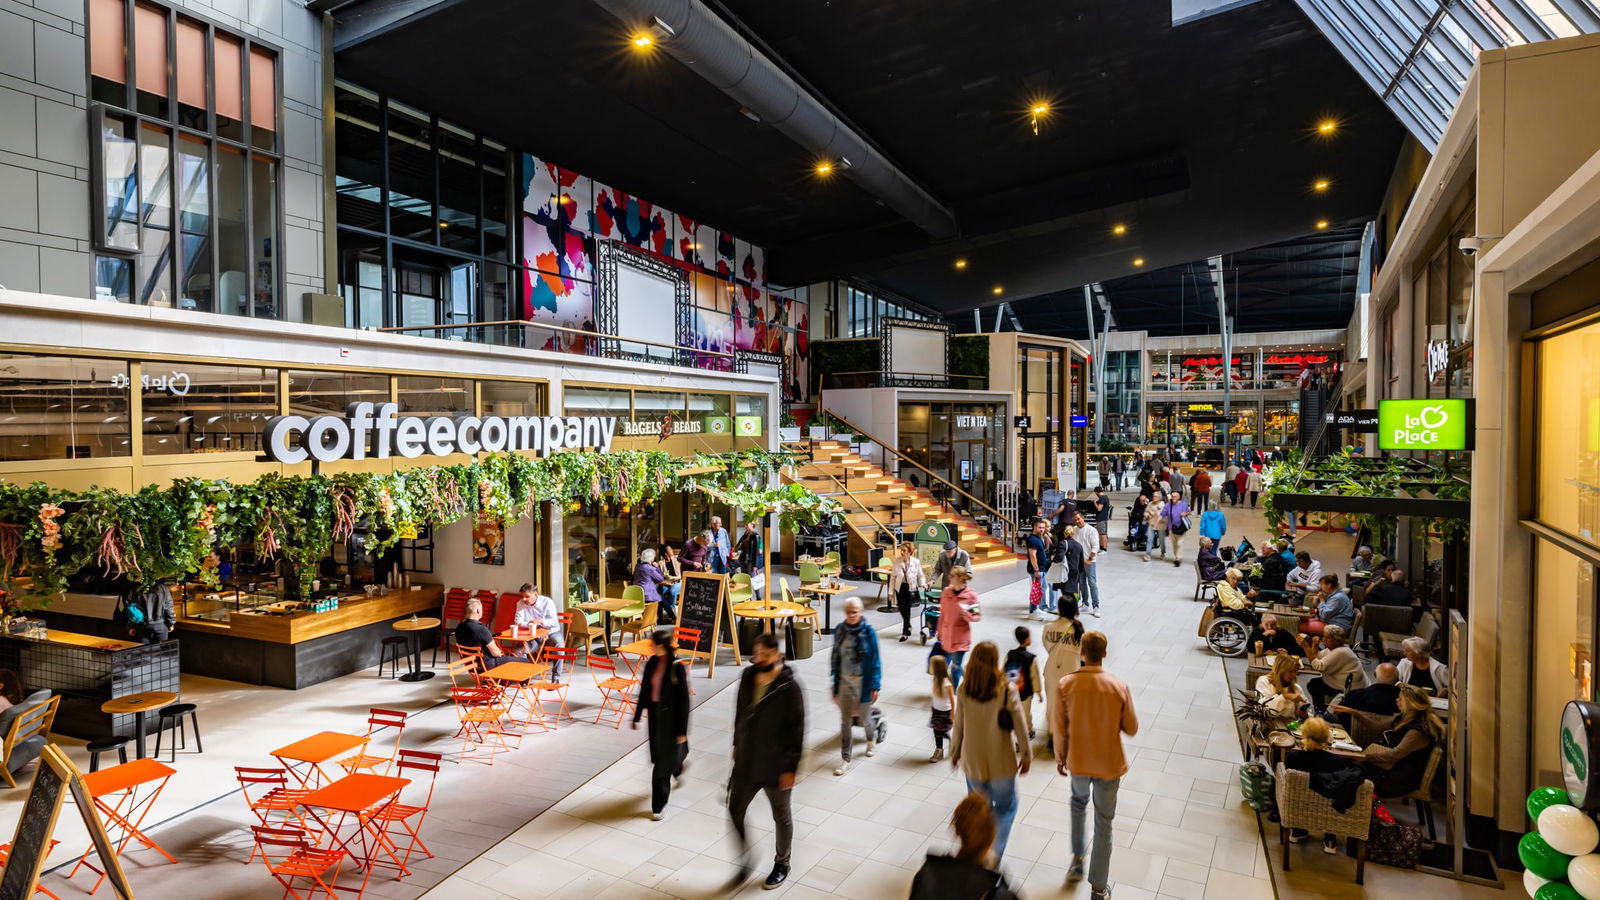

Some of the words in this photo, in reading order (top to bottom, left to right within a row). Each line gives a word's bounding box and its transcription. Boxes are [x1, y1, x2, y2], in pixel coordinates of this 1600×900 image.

[624, 421, 662, 435] BAGELS
[673, 420, 701, 434] BEANS
[957, 416, 970, 427] VIET
[976, 416, 987, 426] TEA
[267, 401, 617, 464] coffeecompany
